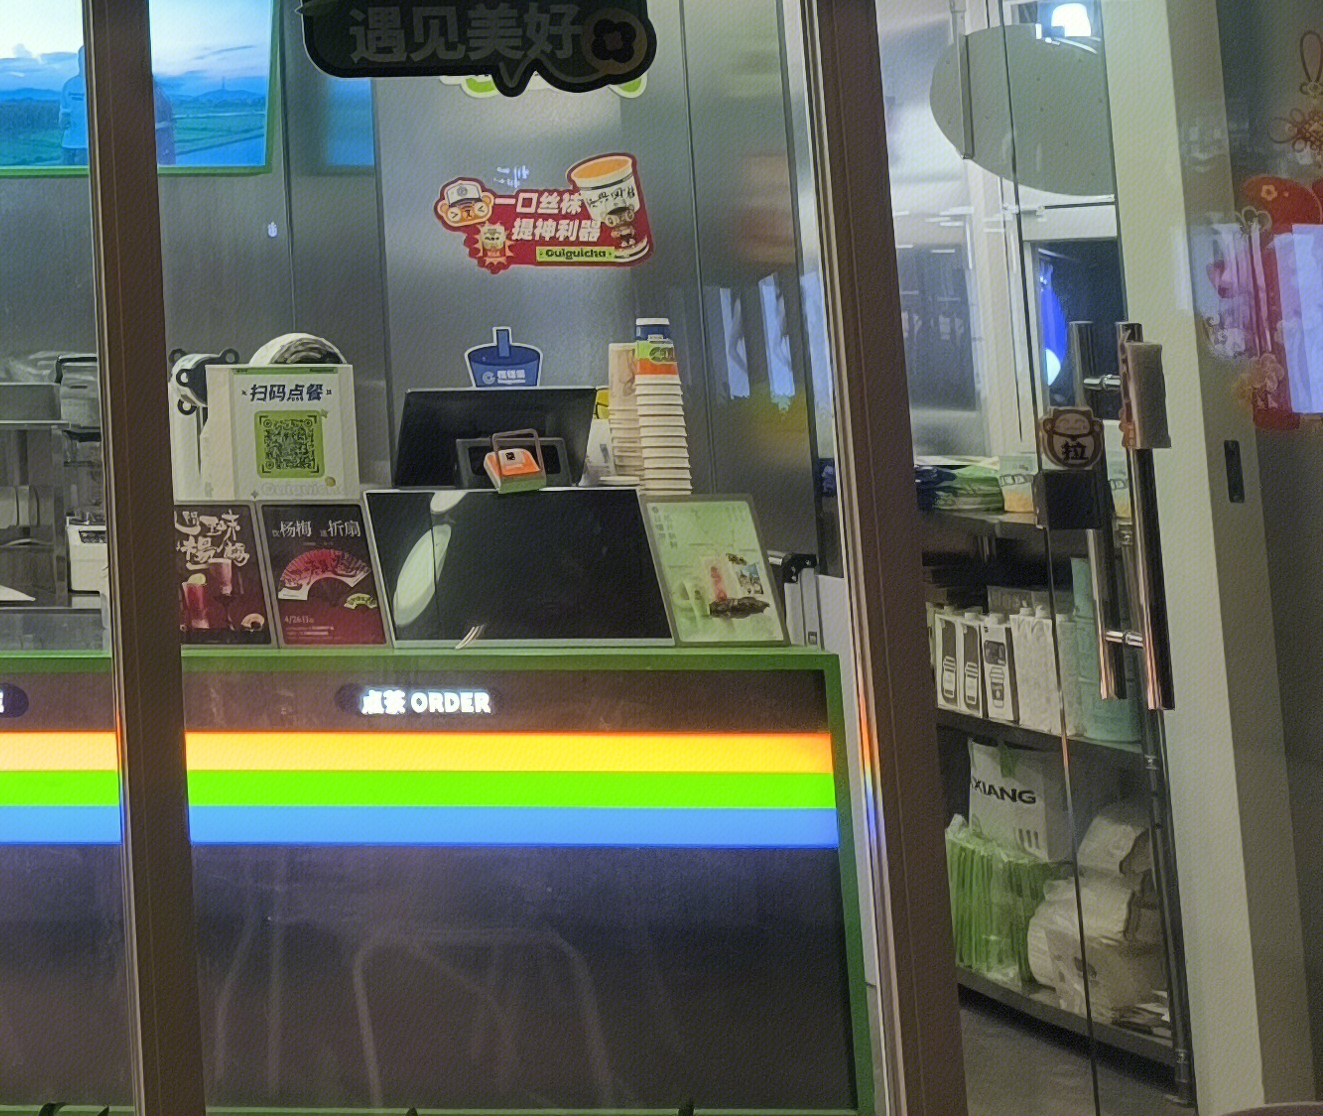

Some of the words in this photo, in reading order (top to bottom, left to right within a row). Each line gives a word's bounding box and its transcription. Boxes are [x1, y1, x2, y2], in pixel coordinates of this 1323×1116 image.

[349, 2, 585, 64] 遇见美好
[512, 218, 602, 242] 提神利器
[545, 248, 607, 261] Guiguicha
[250, 384, 324, 402] 扫码点餐
[1060, 440, 1089, 462] 拉
[410, 692, 492, 714] ORDER
